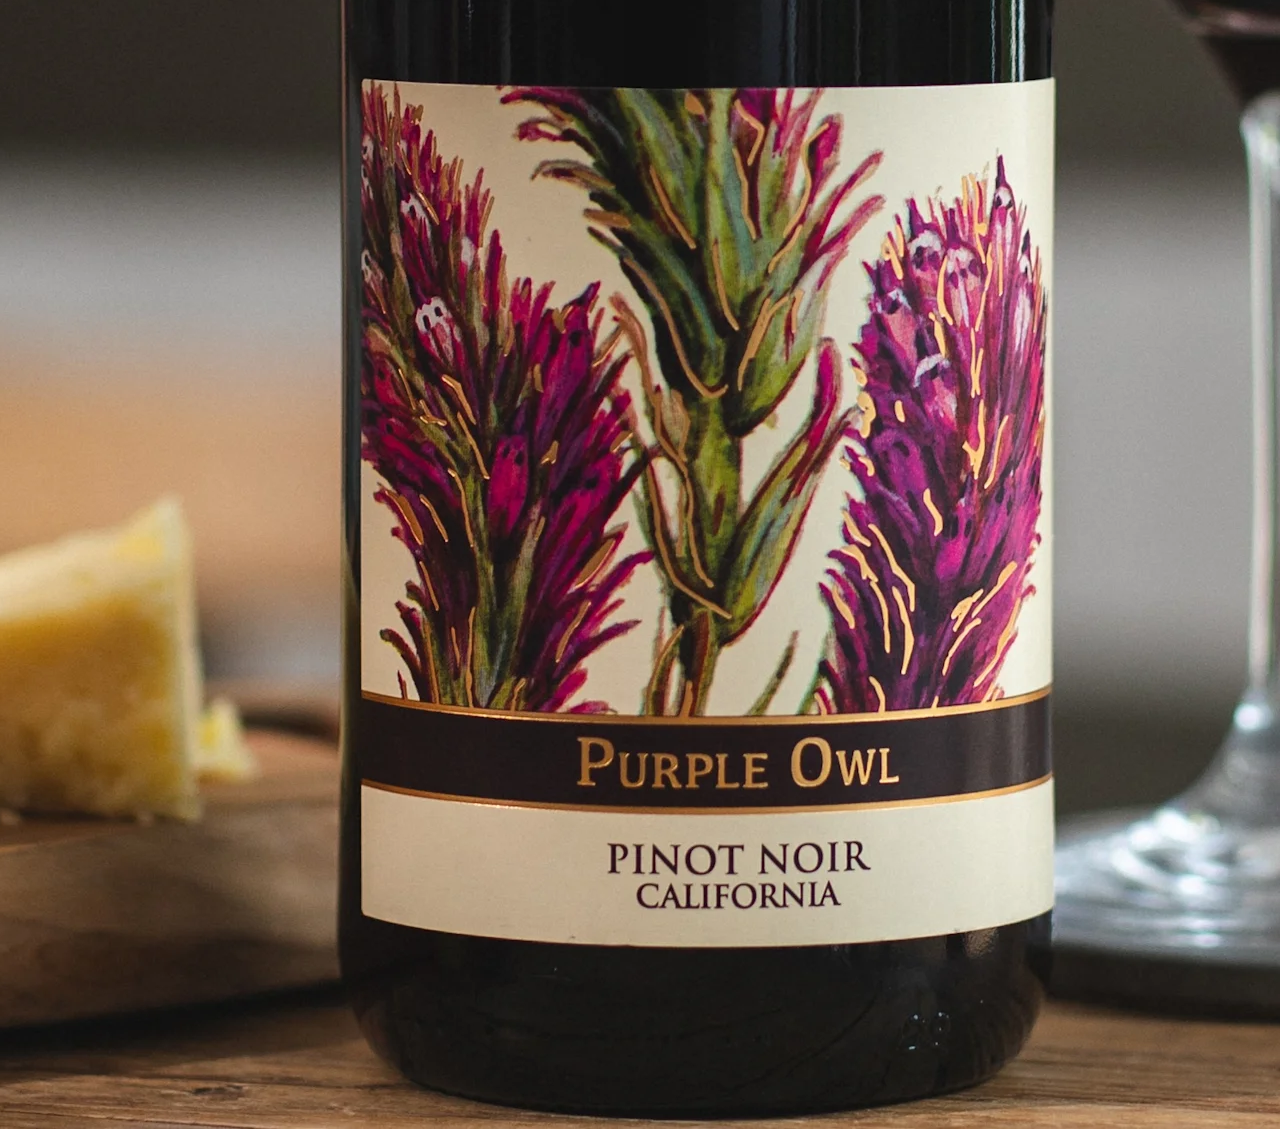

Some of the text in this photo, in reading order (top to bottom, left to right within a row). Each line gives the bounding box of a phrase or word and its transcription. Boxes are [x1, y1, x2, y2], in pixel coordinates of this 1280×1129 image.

[576, 736, 900, 790] PURPLE OWL
[606, 840, 872, 876] PINOT NOIR
[635, 880, 842, 910] CALIFORNIA
